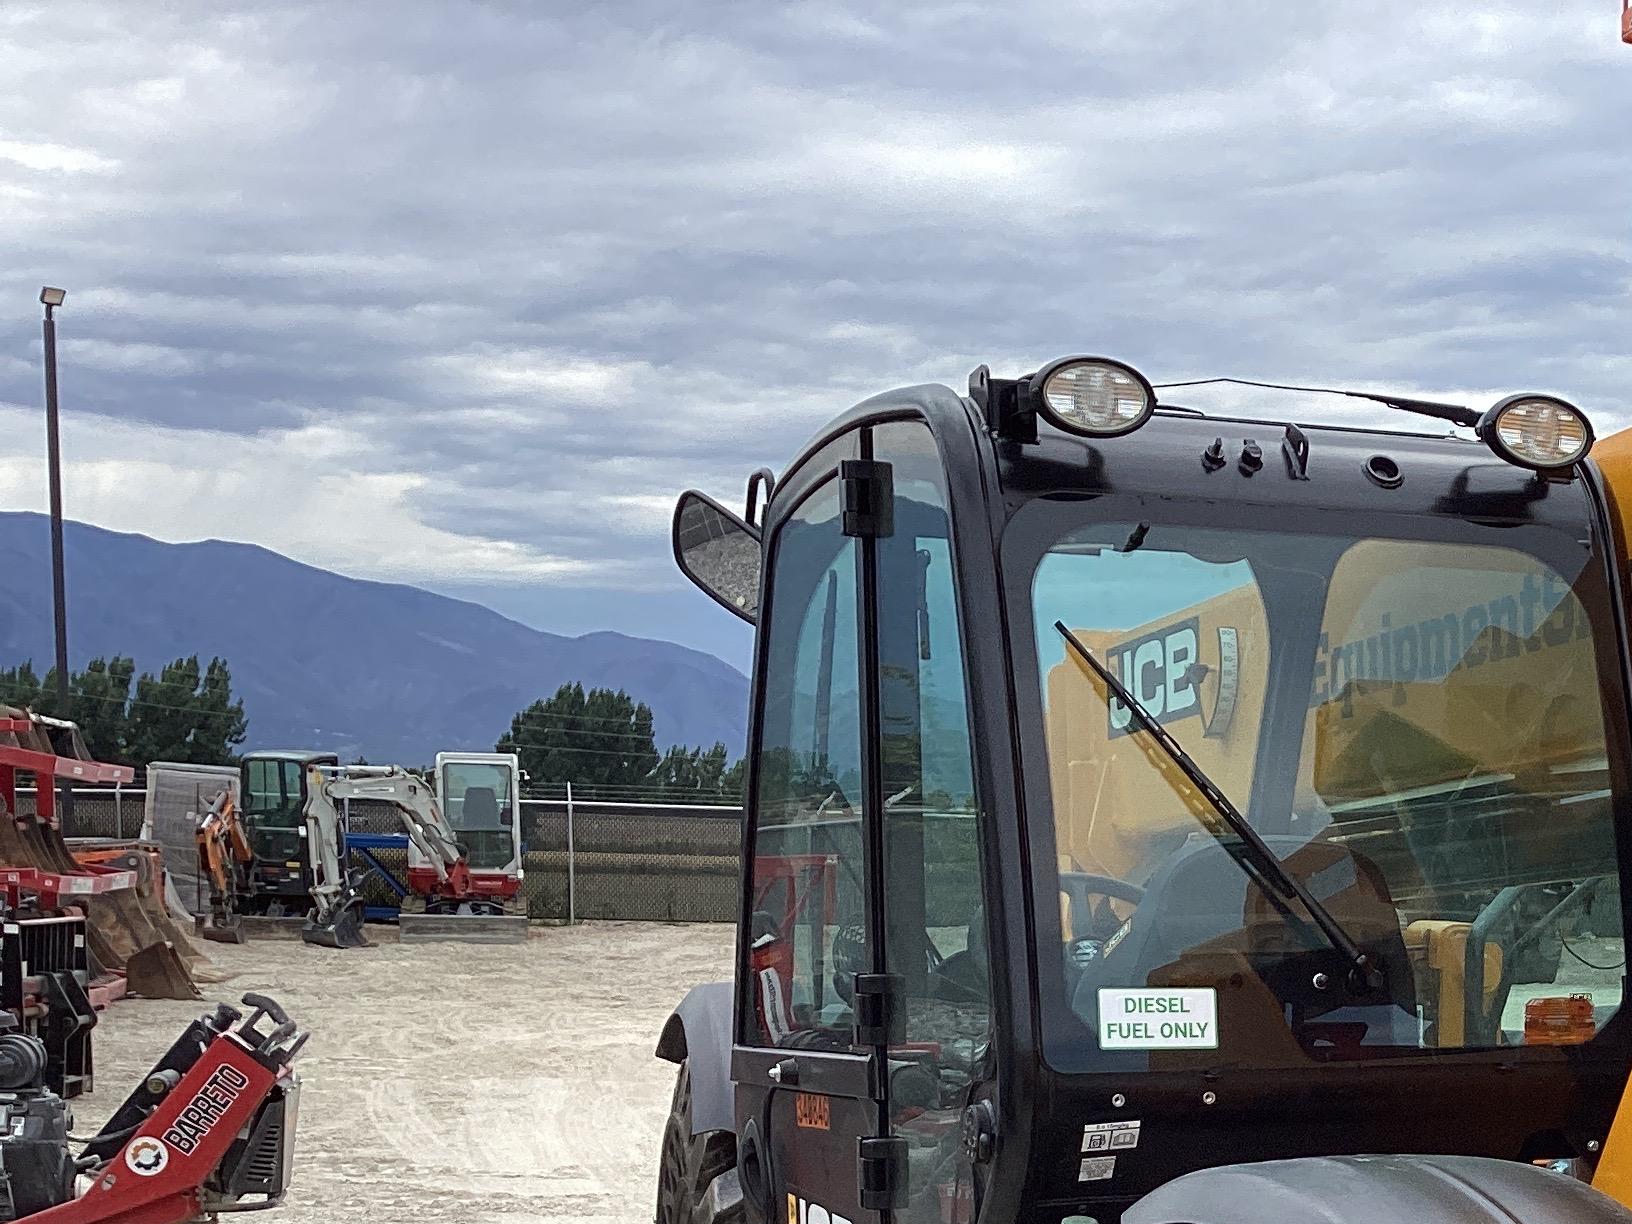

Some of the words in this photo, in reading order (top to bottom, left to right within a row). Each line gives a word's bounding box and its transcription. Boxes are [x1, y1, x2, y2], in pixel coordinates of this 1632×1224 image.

[1109, 628, 1197, 730] JCB
[1106, 1022, 1155, 1039] FUEL
[1160, 1021, 1208, 1038] ONLY
[1124, 997, 1191, 1013] DIESEL
[161, 1062, 249, 1157] BARRETO
